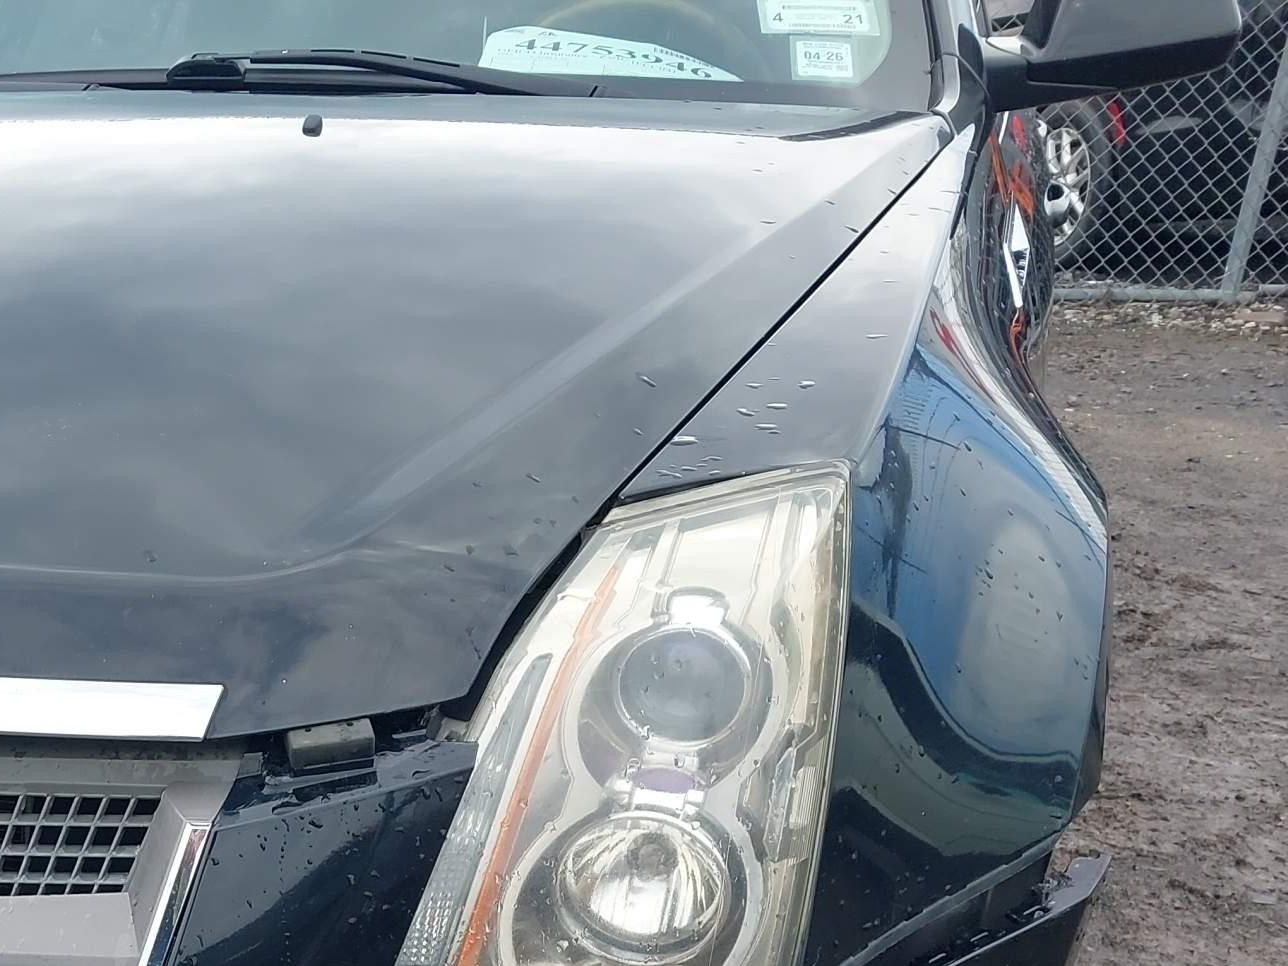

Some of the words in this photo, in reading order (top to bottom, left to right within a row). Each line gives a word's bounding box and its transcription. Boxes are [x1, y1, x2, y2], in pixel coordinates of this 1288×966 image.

[772, 12, 783, 22] 4
[843, 14, 863, 24] 21
[515, 39, 712, 78] 44753946
[804, 51, 820, 60] 04
[826, 51, 844, 61] 26
